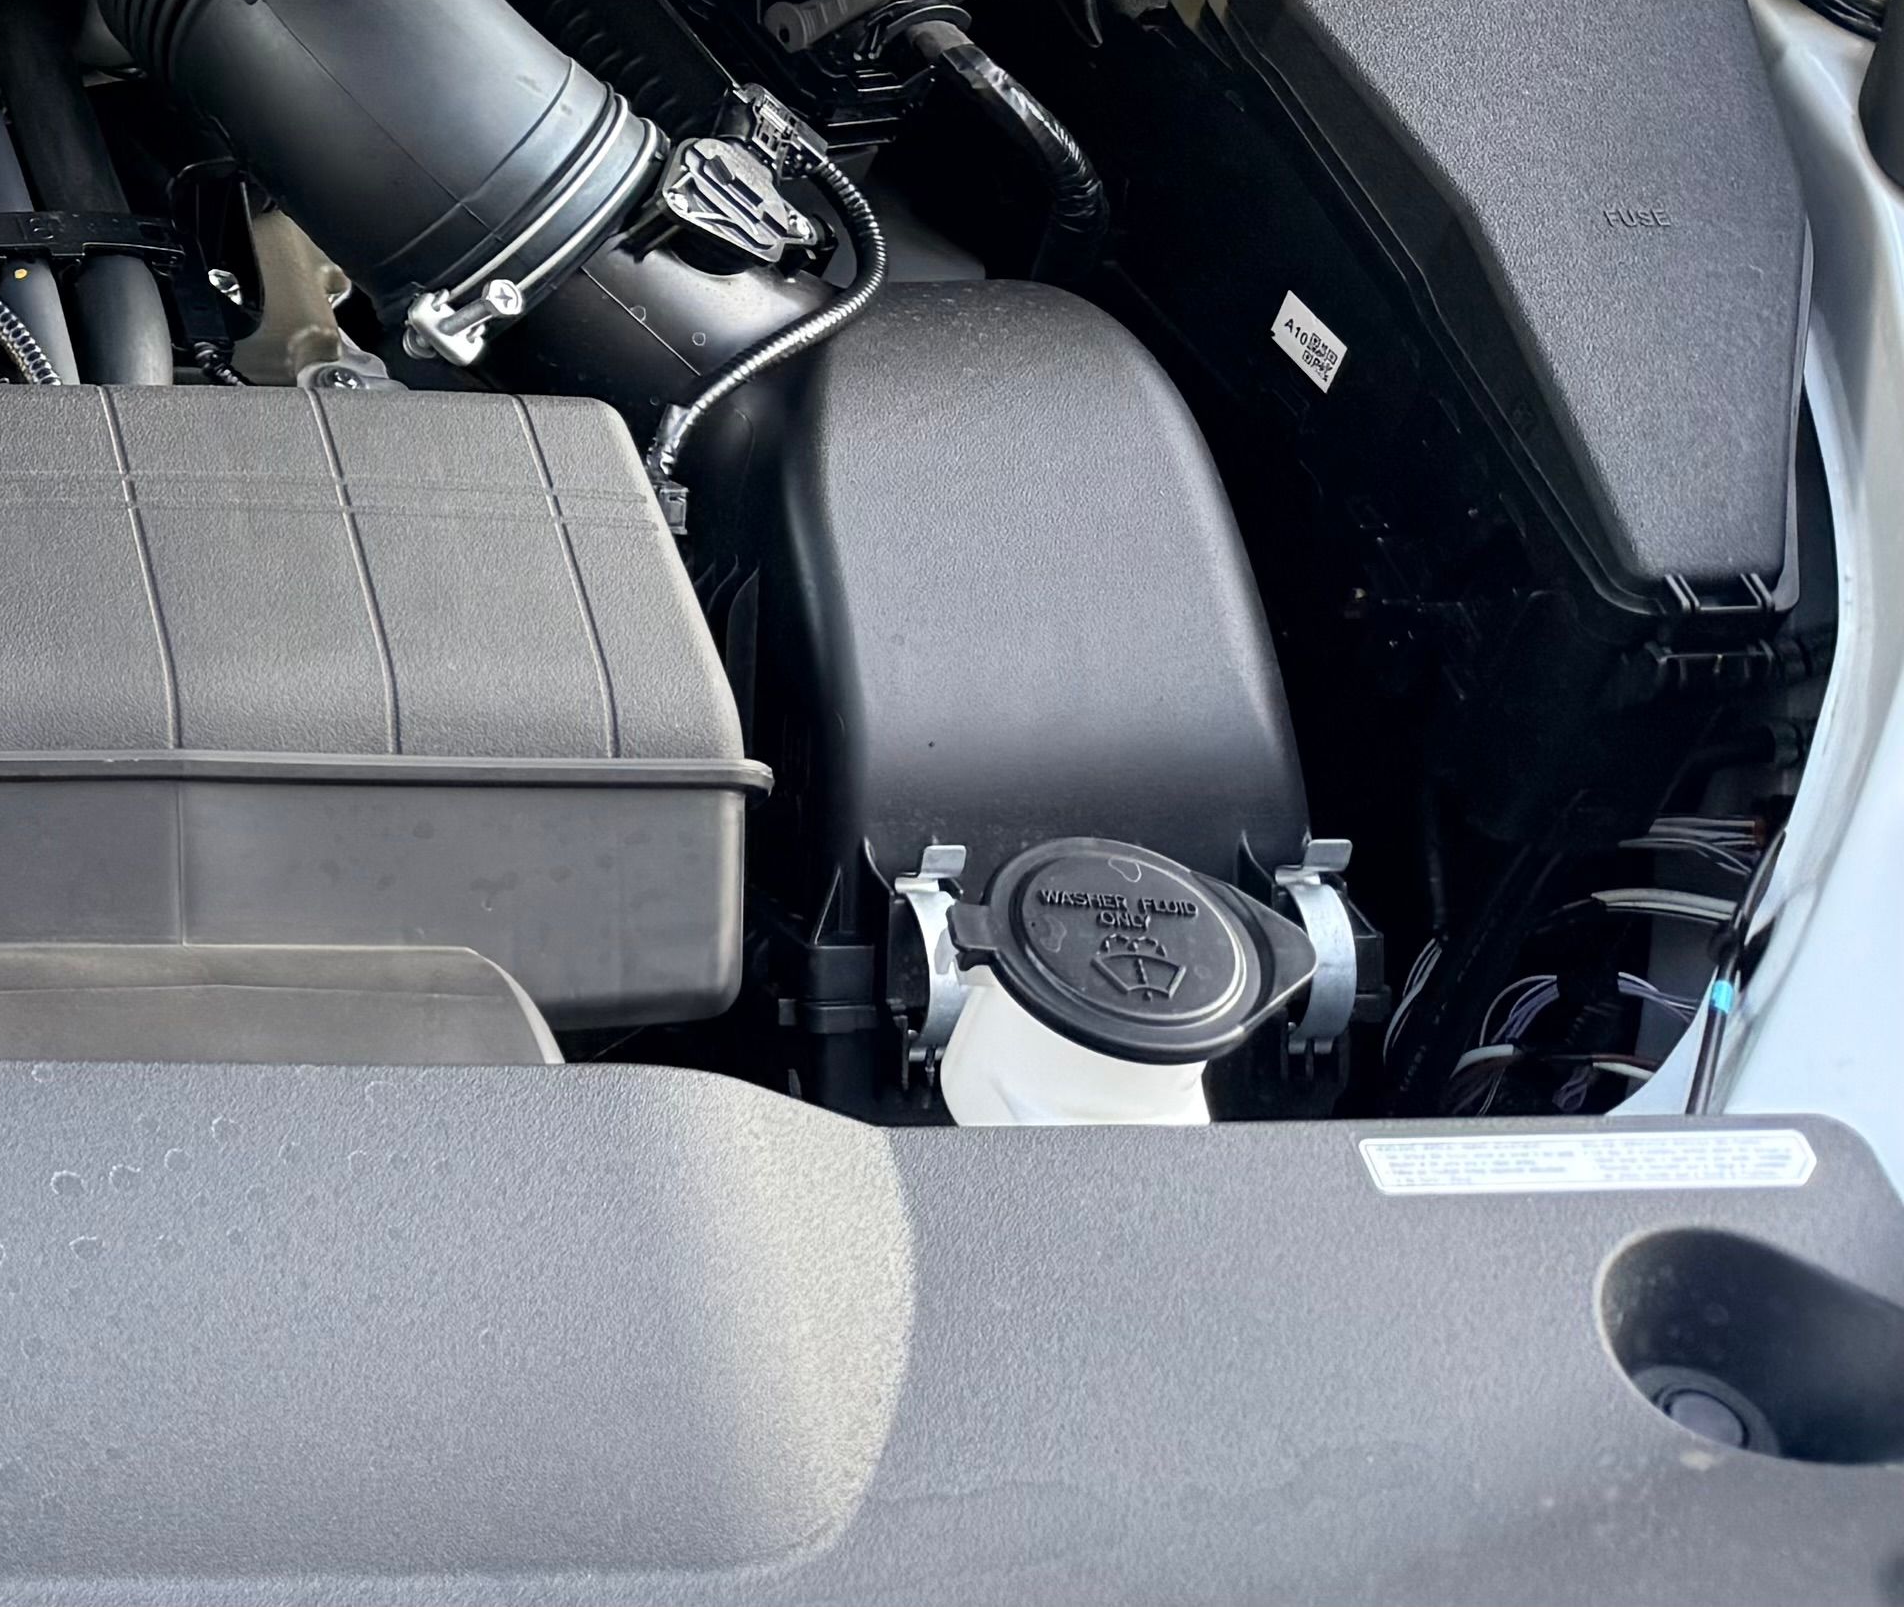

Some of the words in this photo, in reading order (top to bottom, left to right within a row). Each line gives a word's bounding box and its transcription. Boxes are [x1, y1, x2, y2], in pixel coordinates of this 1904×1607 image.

[1602, 208, 1672, 228] FUSE
[1284, 317, 1309, 346] A10
[1039, 889, 1129, 911] WASHER
[1137, 897, 1199, 917] FLUID
[1096, 910, 1152, 931] ONLY
